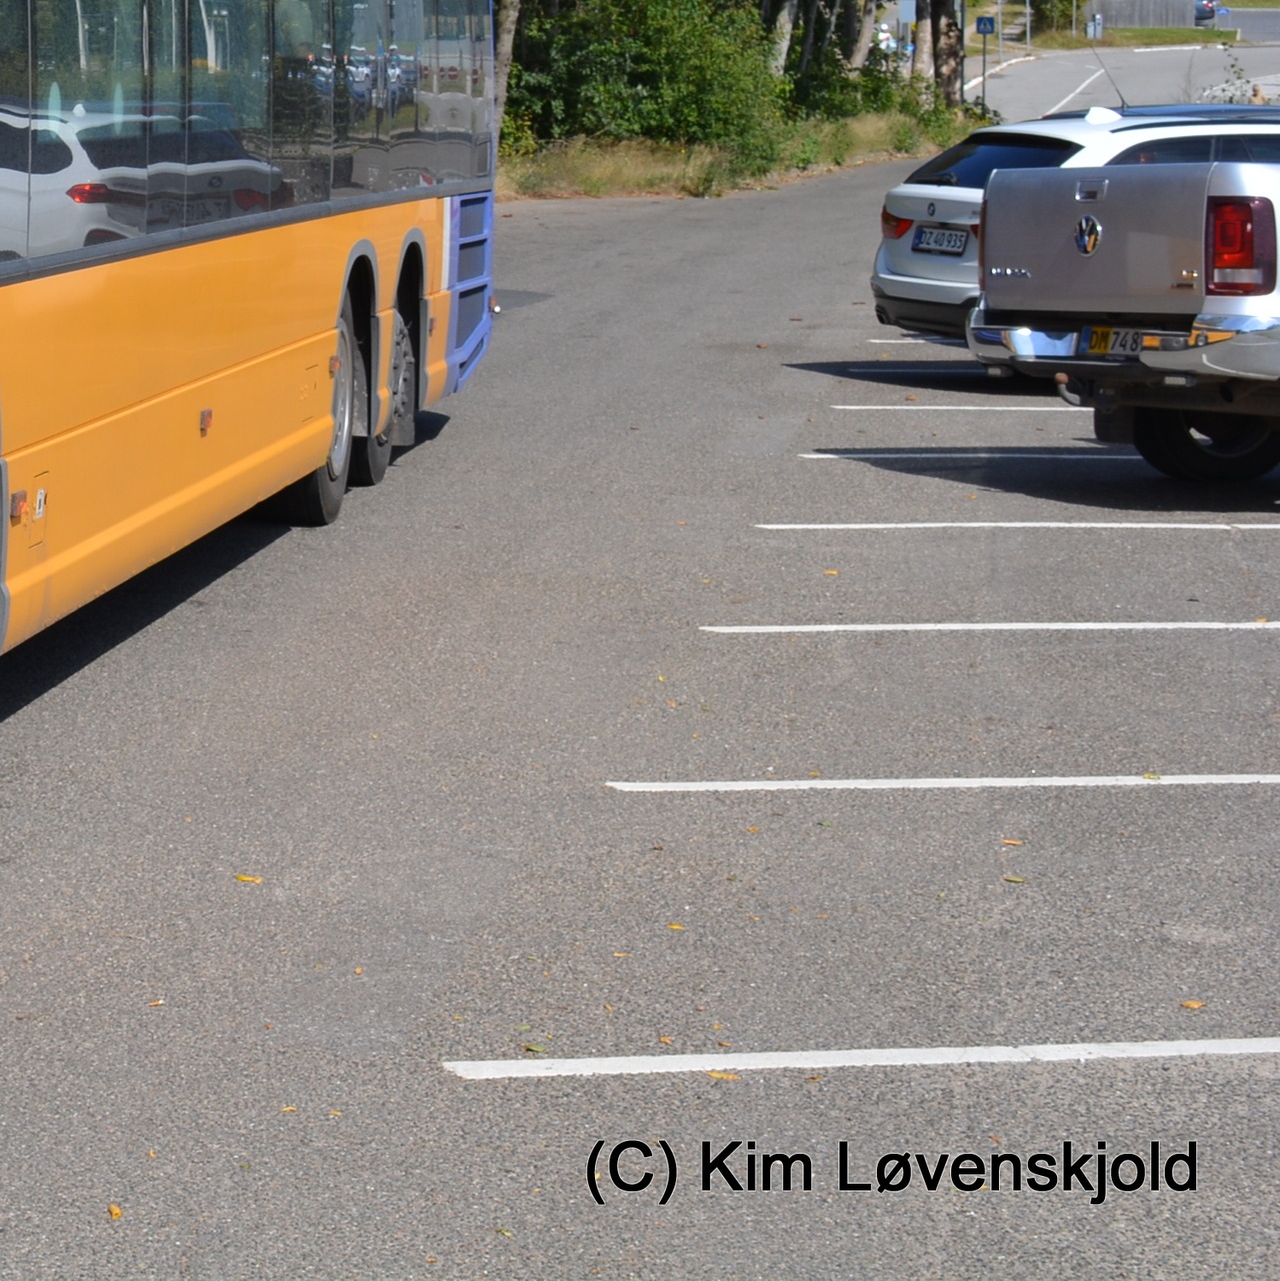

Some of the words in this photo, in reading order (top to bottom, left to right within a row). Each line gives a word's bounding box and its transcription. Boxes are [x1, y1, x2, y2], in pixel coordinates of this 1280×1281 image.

[920, 230, 933, 246] DZ
[933, 232, 945, 247] 40
[946, 233, 965, 249] 935
